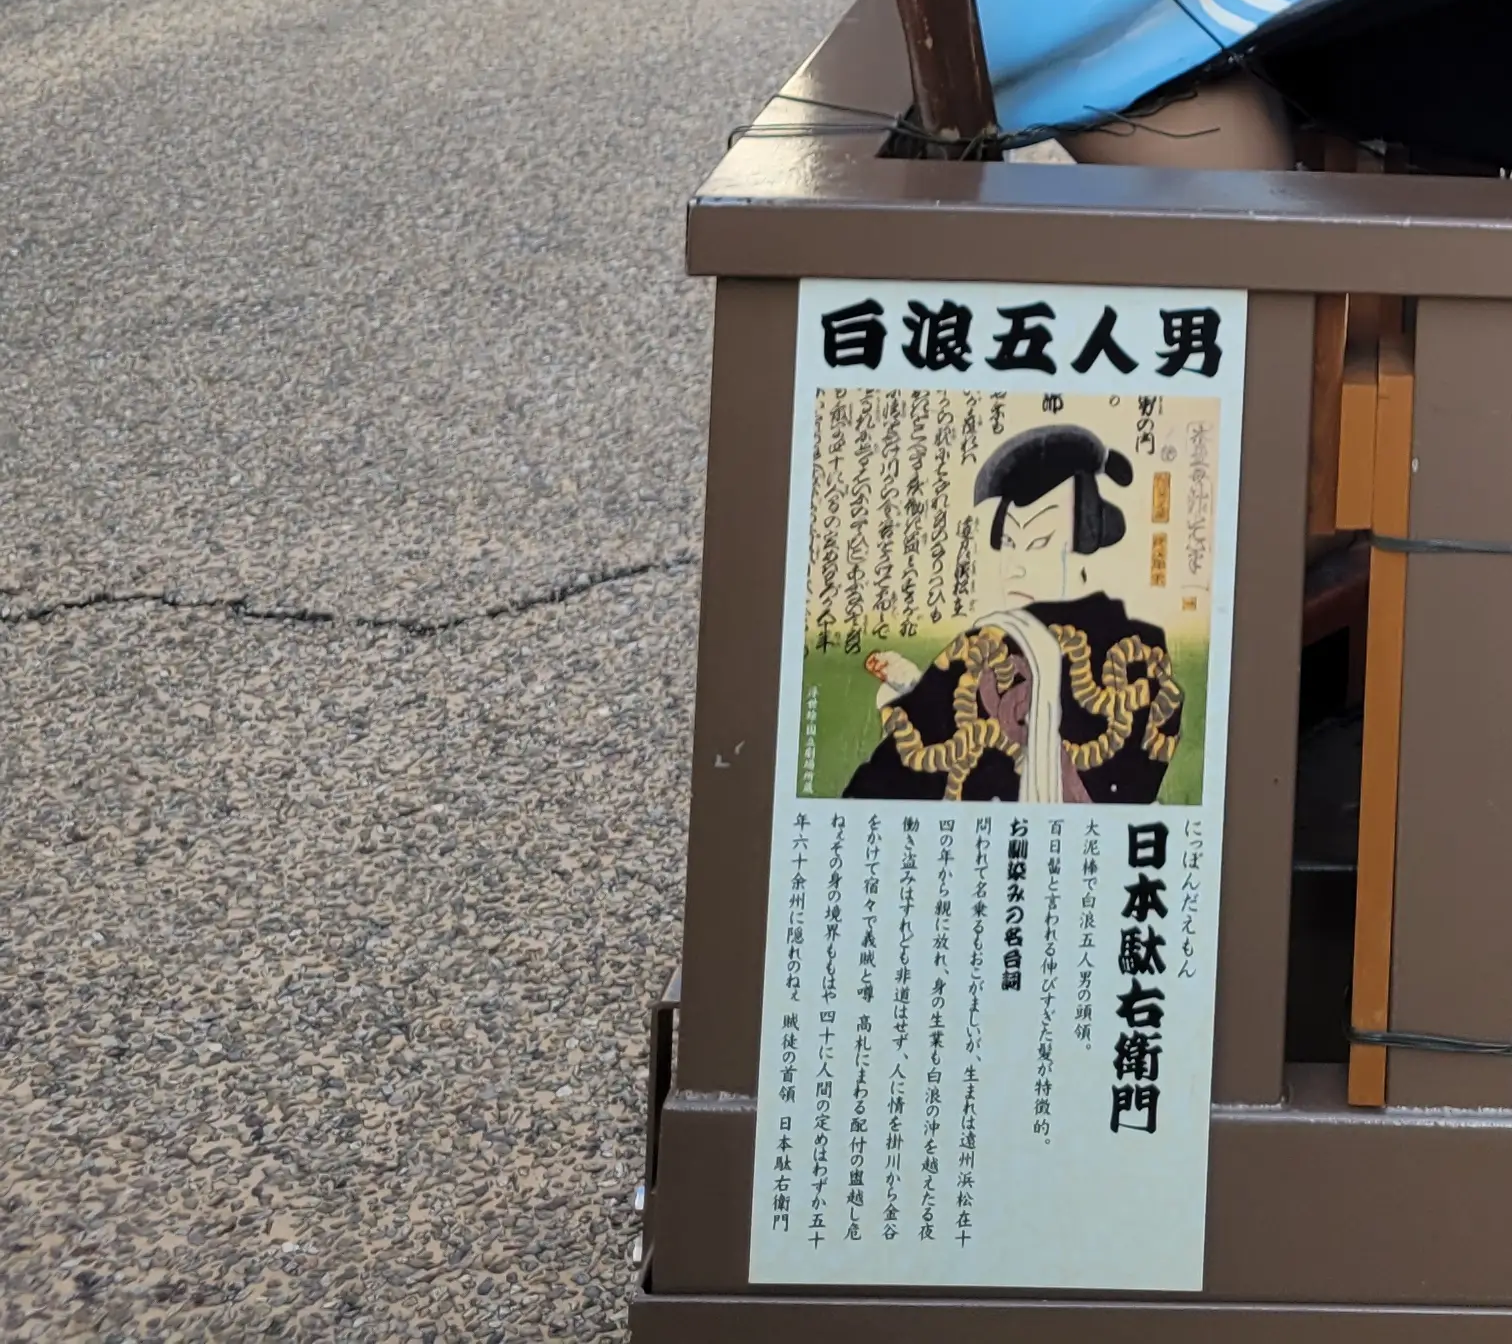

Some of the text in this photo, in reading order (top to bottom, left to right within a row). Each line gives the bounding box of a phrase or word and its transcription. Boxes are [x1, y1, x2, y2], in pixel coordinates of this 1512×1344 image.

[820, 297, 1223, 378] 白浪五人男
[1110, 820, 1169, 1135] 日本駄右衛門
[1177, 819, 1203, 979] にっぽんだえもん
